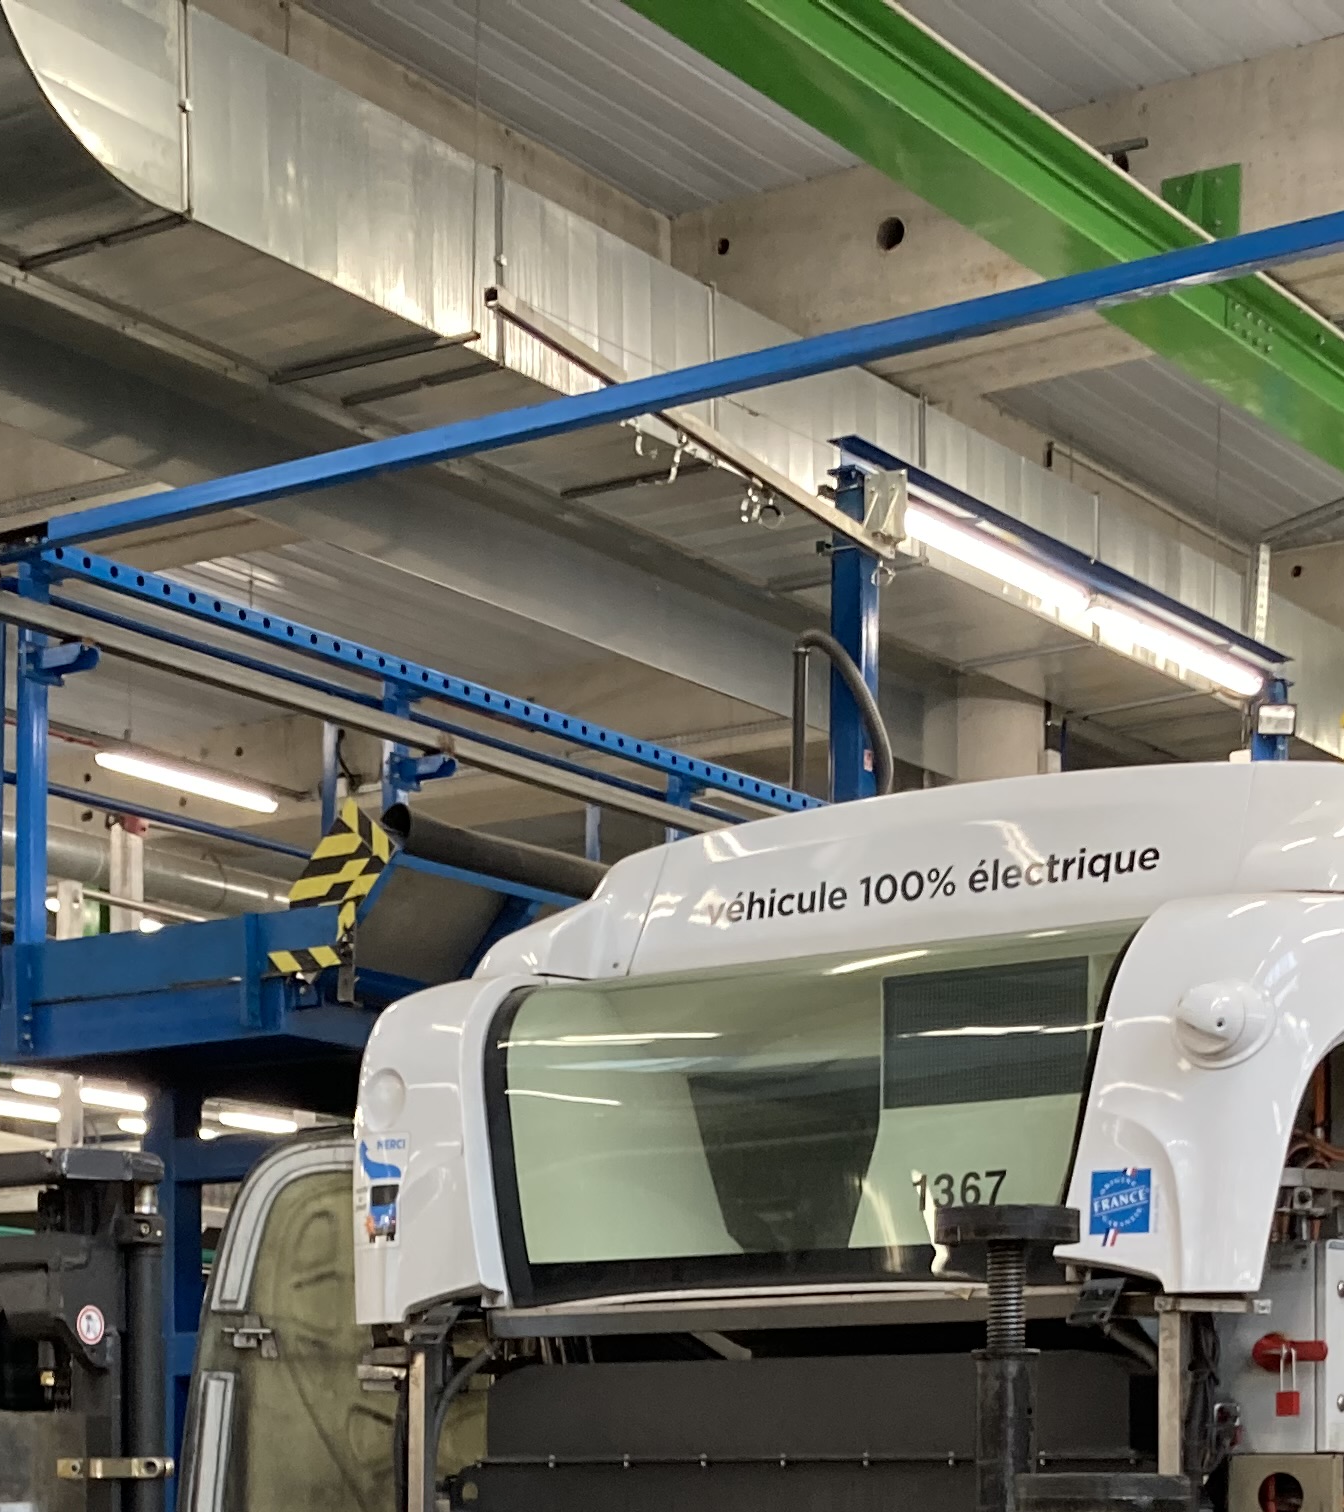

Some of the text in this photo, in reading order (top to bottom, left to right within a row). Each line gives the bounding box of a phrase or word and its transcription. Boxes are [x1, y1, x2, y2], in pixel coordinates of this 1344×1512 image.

[706, 846, 1160, 926] véhicule 100% électrique
[912, 1169, 1008, 1212] 1367
[1093, 1188, 1147, 1213] FRANCE
